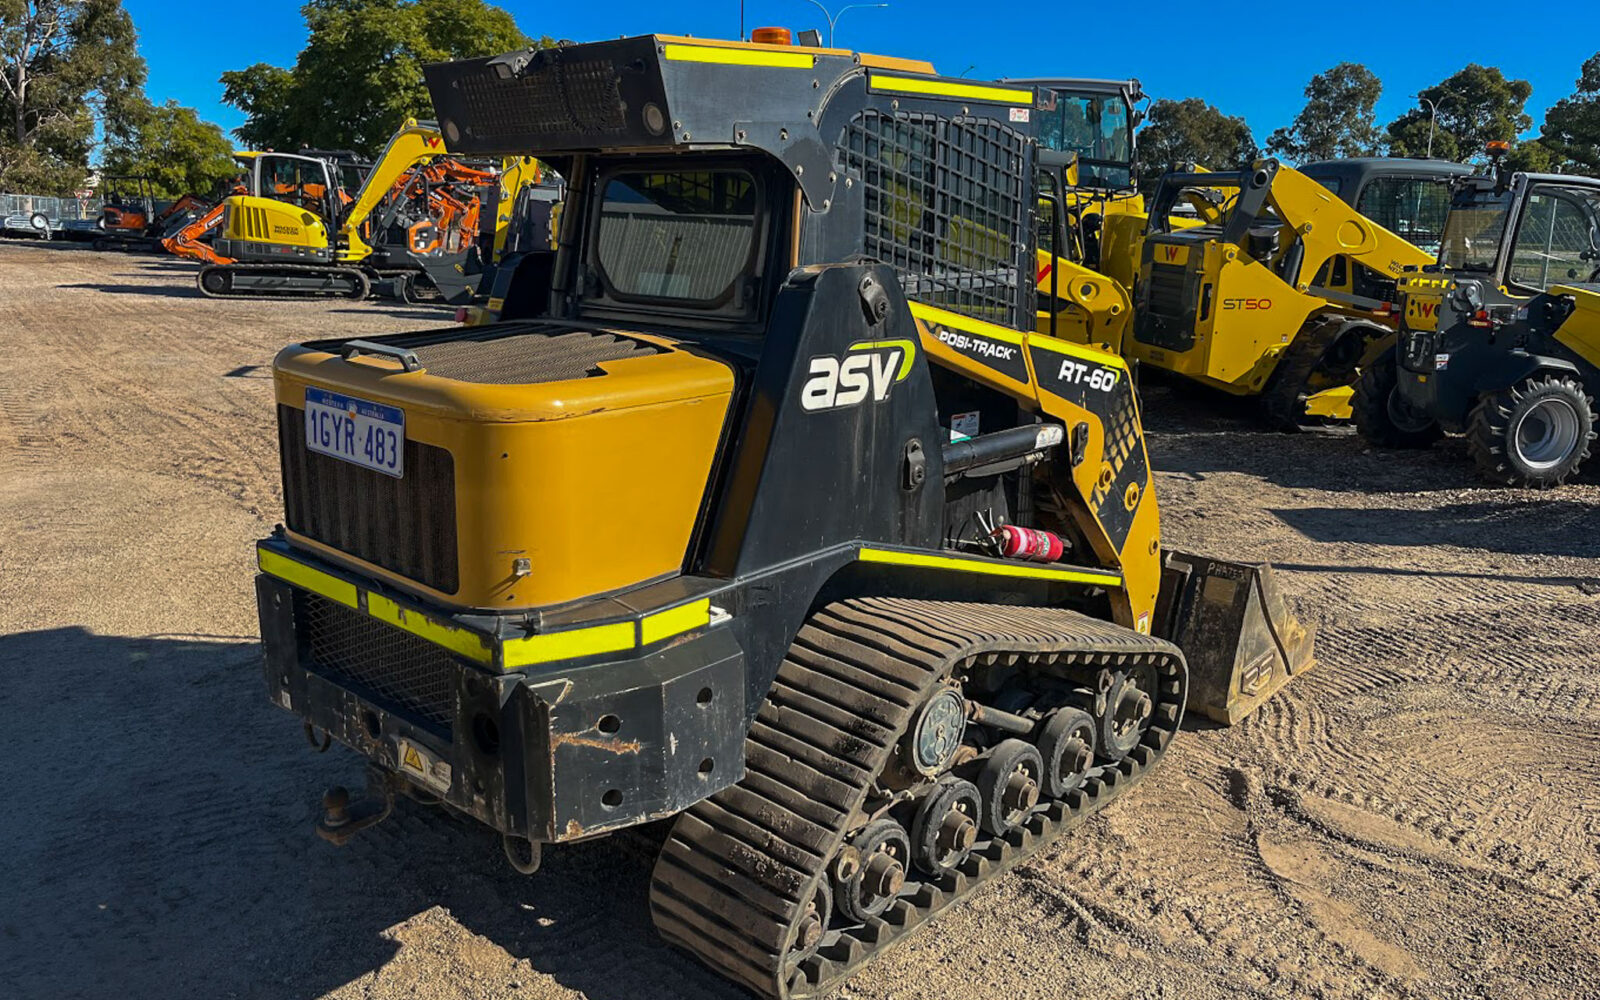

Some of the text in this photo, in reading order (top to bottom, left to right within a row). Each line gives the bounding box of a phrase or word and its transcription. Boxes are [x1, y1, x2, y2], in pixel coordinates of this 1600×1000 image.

[1223, 298, 1272, 310] ST50
[1057, 359, 1116, 393] RT-60
[361, 408, 385, 420] AUSTRALIA
